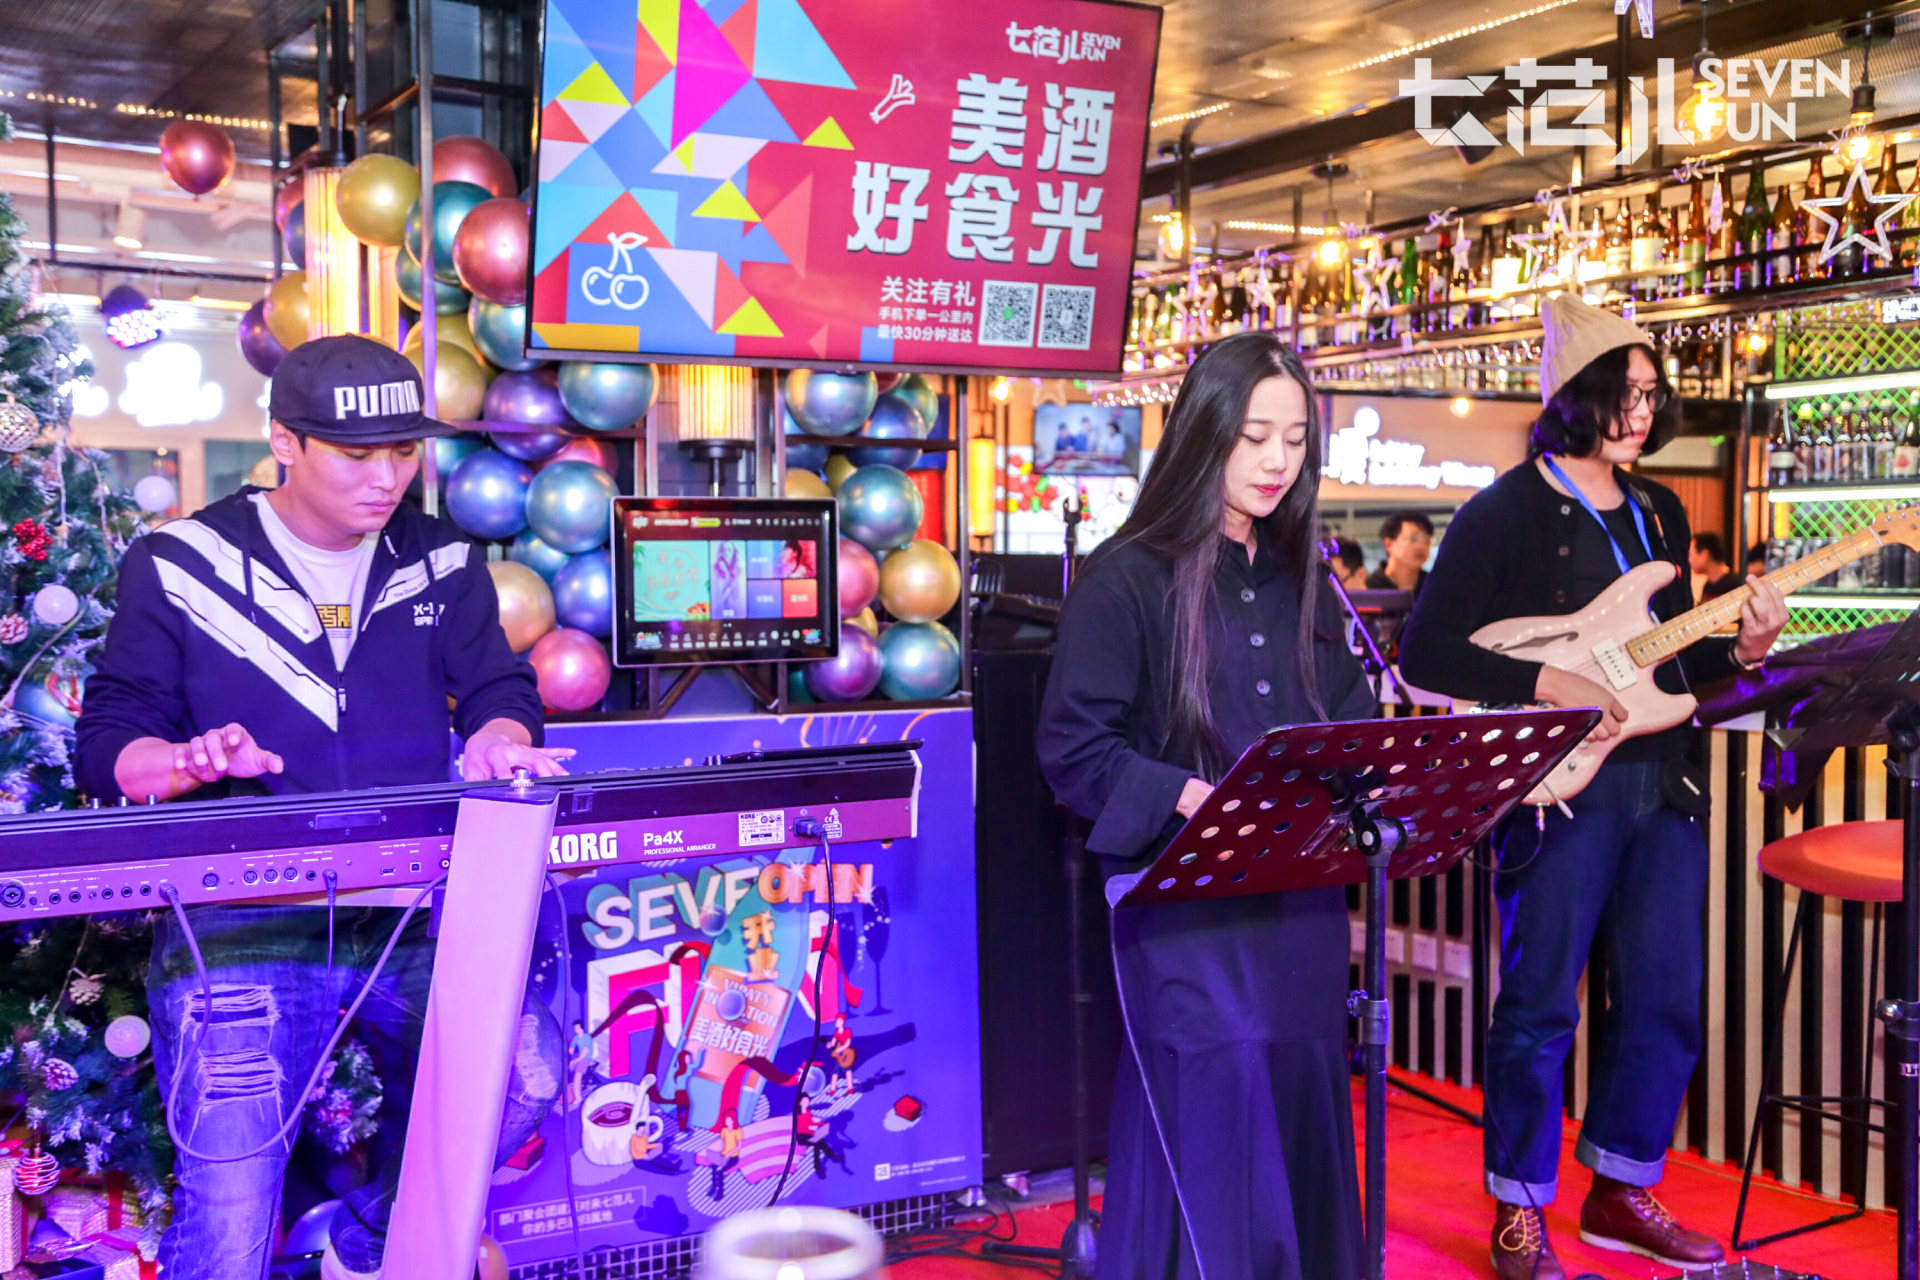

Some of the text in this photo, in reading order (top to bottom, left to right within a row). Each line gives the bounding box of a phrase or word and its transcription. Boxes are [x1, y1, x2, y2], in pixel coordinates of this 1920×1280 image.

[1081, 46, 1106, 62] FUN
[1082, 32, 1121, 50] SEVEN
[949, 73, 1115, 176] 美酒
[846, 161, 1103, 268] 好食光
[881, 276, 976, 307] 关注有礼
[878, 305, 974, 325] 手机下单一公里内
[877, 324, 974, 343] 最快30分钟送达
[334, 380, 421, 420] PUMA
[547, 831, 617, 864] KORG
[643, 830, 684, 846] Pa4X
[644, 843, 716, 855] PROFESSIONAL ARRANGER
[758, 861, 874, 904] OPEN
[690, 1016, 769, 1058] 美酒好食光
